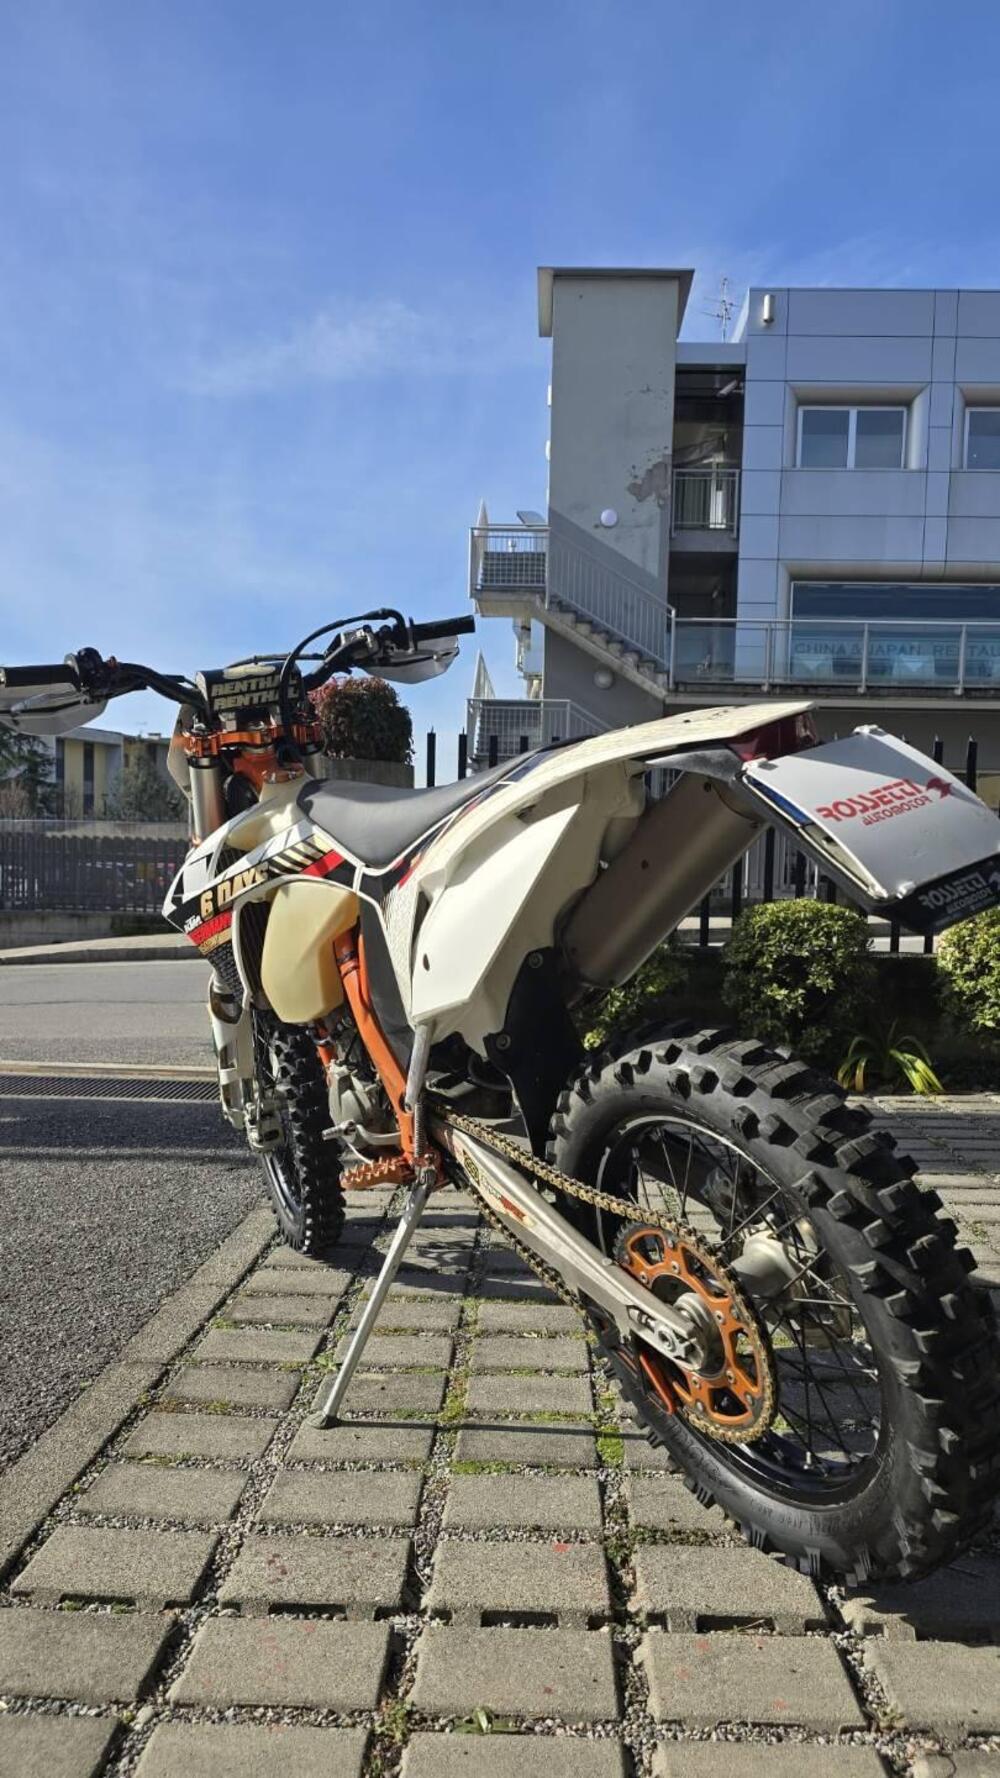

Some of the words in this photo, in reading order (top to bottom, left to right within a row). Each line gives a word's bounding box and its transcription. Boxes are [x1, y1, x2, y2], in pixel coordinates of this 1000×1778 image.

[794, 643, 847, 655] CHINA
[867, 643, 921, 656] JAPAN
[933, 644, 1000, 658] RETAU
[200, 889, 214, 920] 6
